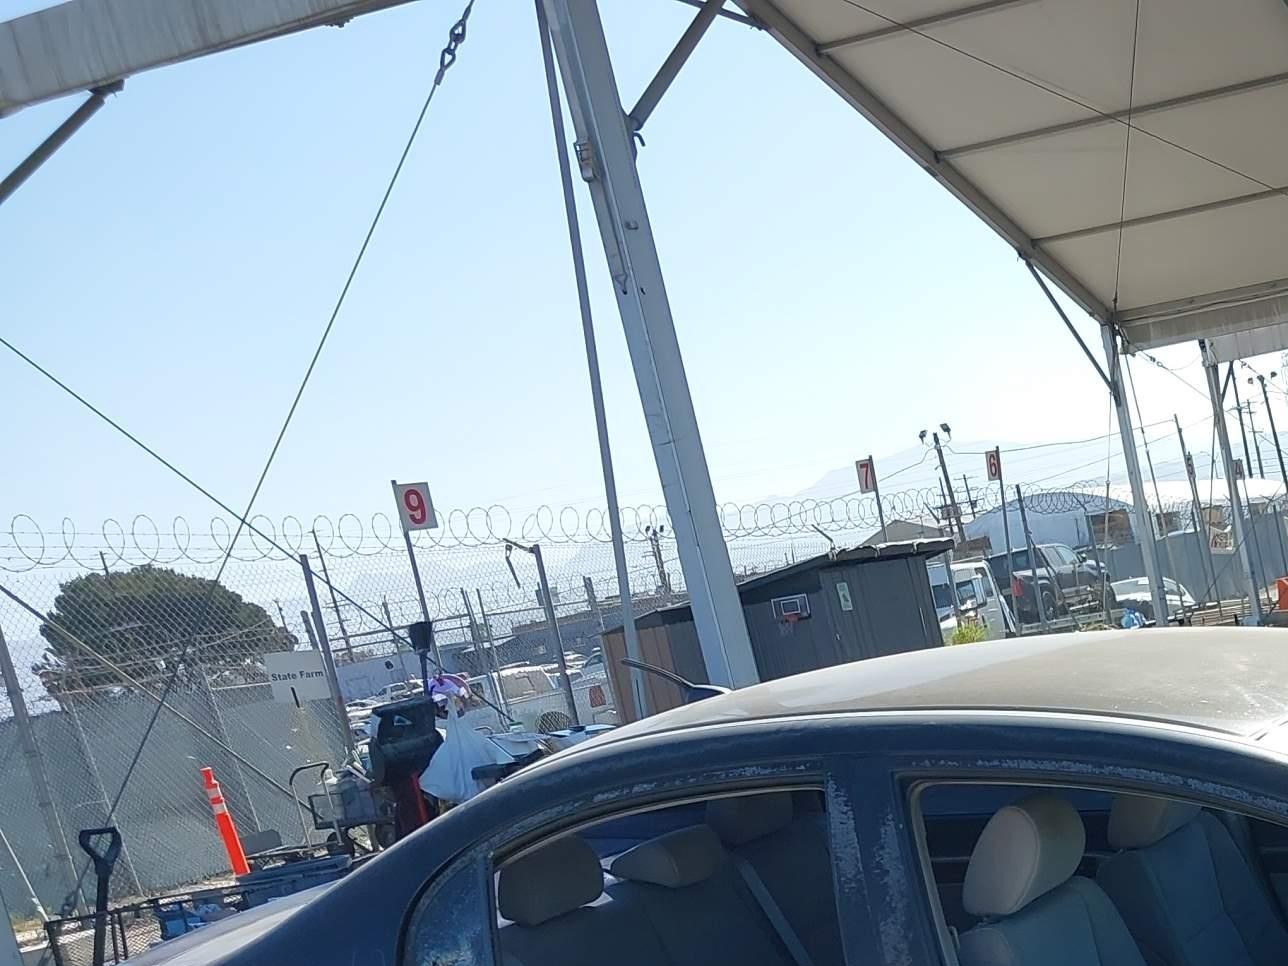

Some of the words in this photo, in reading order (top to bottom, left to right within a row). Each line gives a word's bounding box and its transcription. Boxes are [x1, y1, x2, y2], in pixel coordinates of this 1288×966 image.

[859, 462, 870, 490] 7
[988, 453, 998, 477] 6
[404, 488, 427, 525] 9
[271, 672, 297, 681] State
[299, 670, 324, 679] Farm
